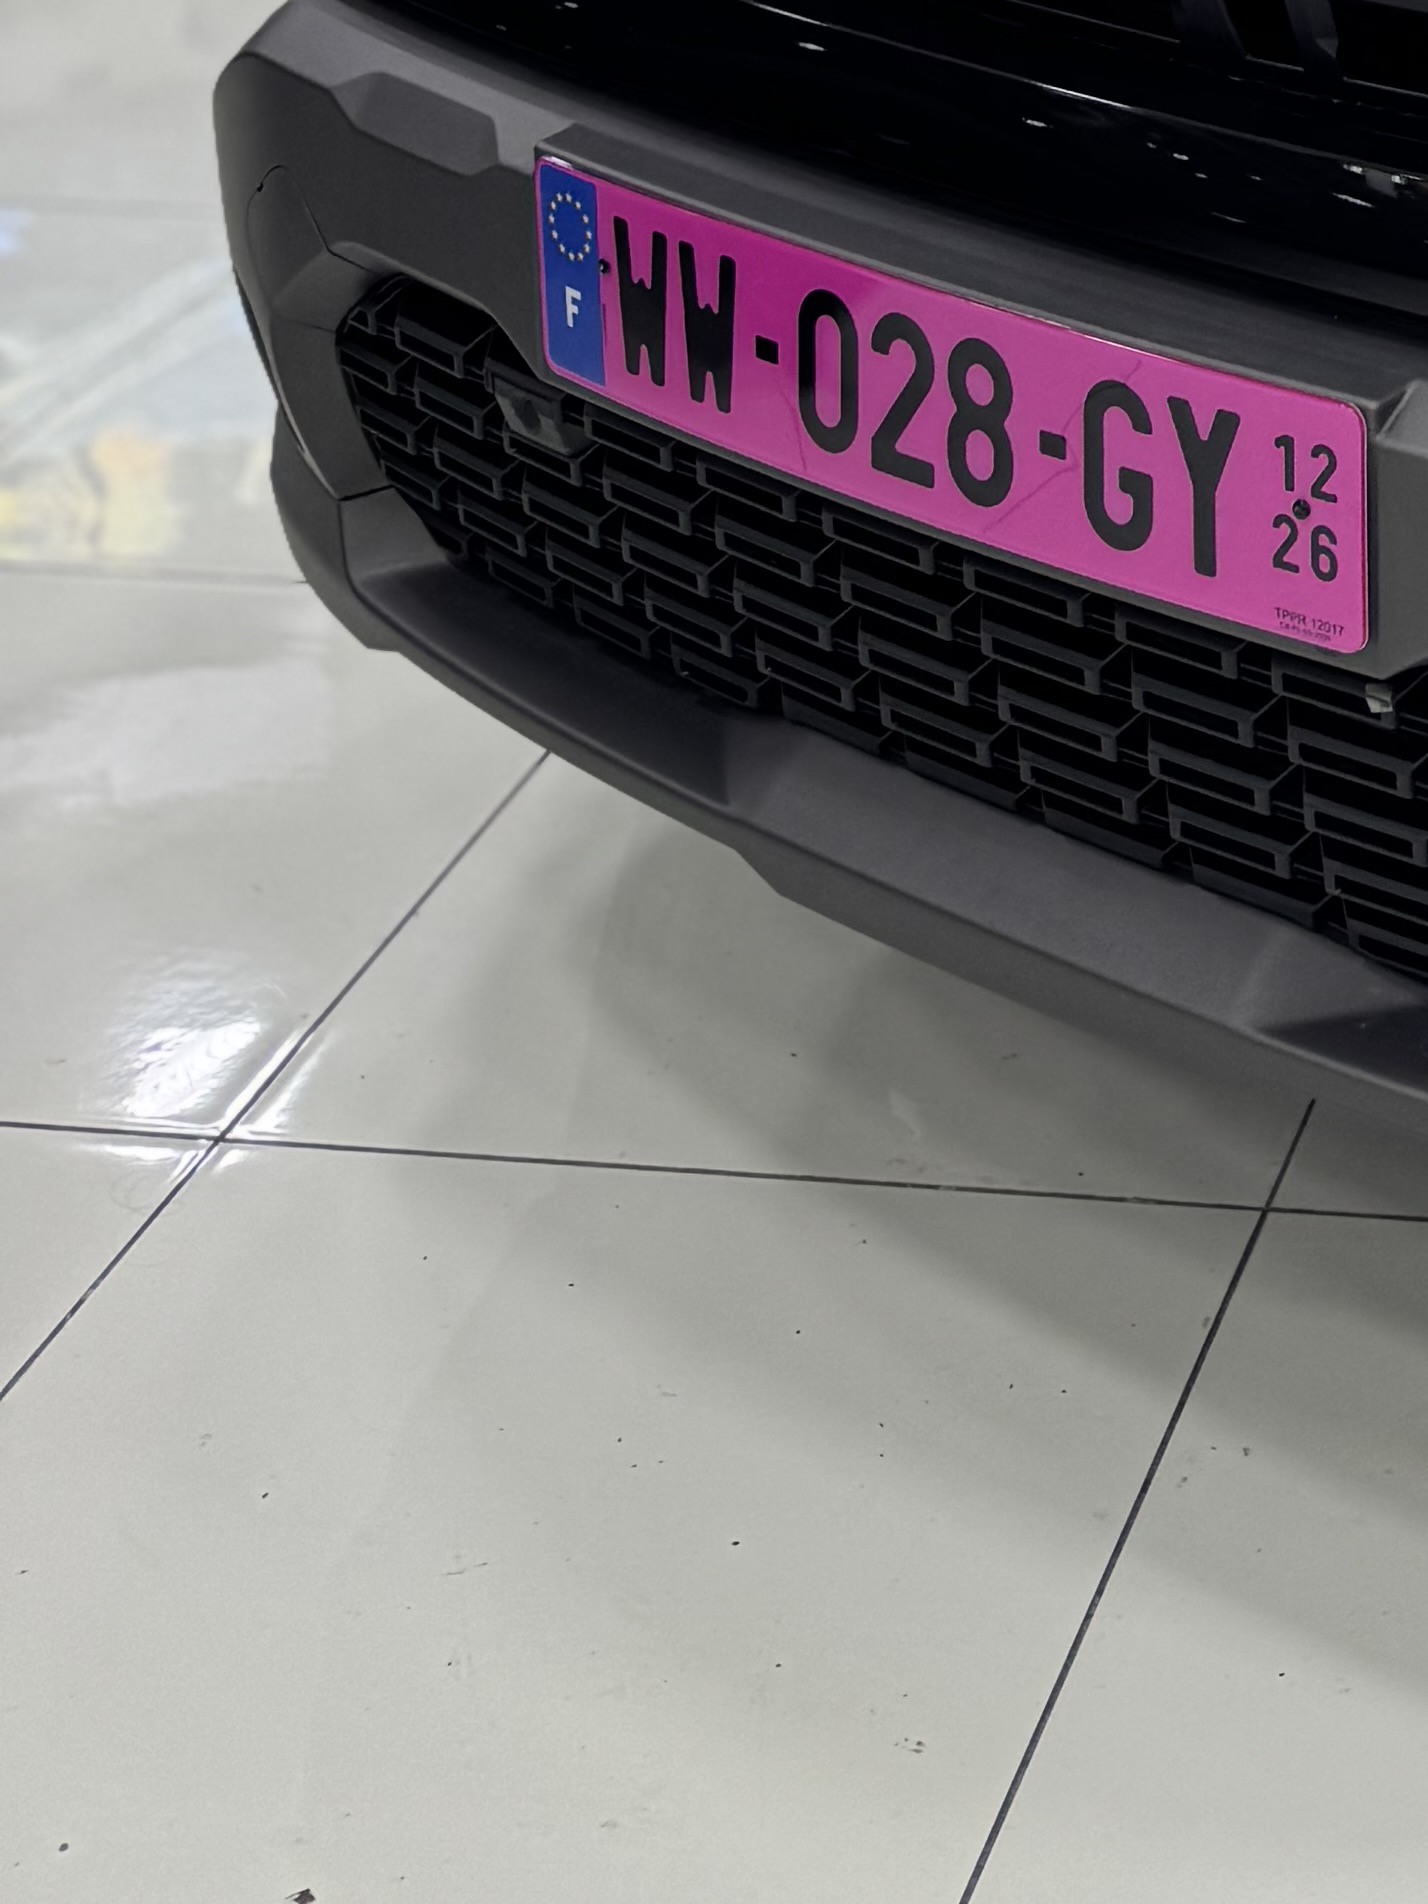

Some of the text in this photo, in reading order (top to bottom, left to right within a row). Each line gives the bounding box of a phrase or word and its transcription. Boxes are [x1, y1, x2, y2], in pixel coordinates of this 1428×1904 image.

[565, 285, 582, 328] F
[612, 215, 1242, 578] WW-028-GY
[1274, 434, 1338, 504] 12
[1272, 513, 1339, 582] 26
